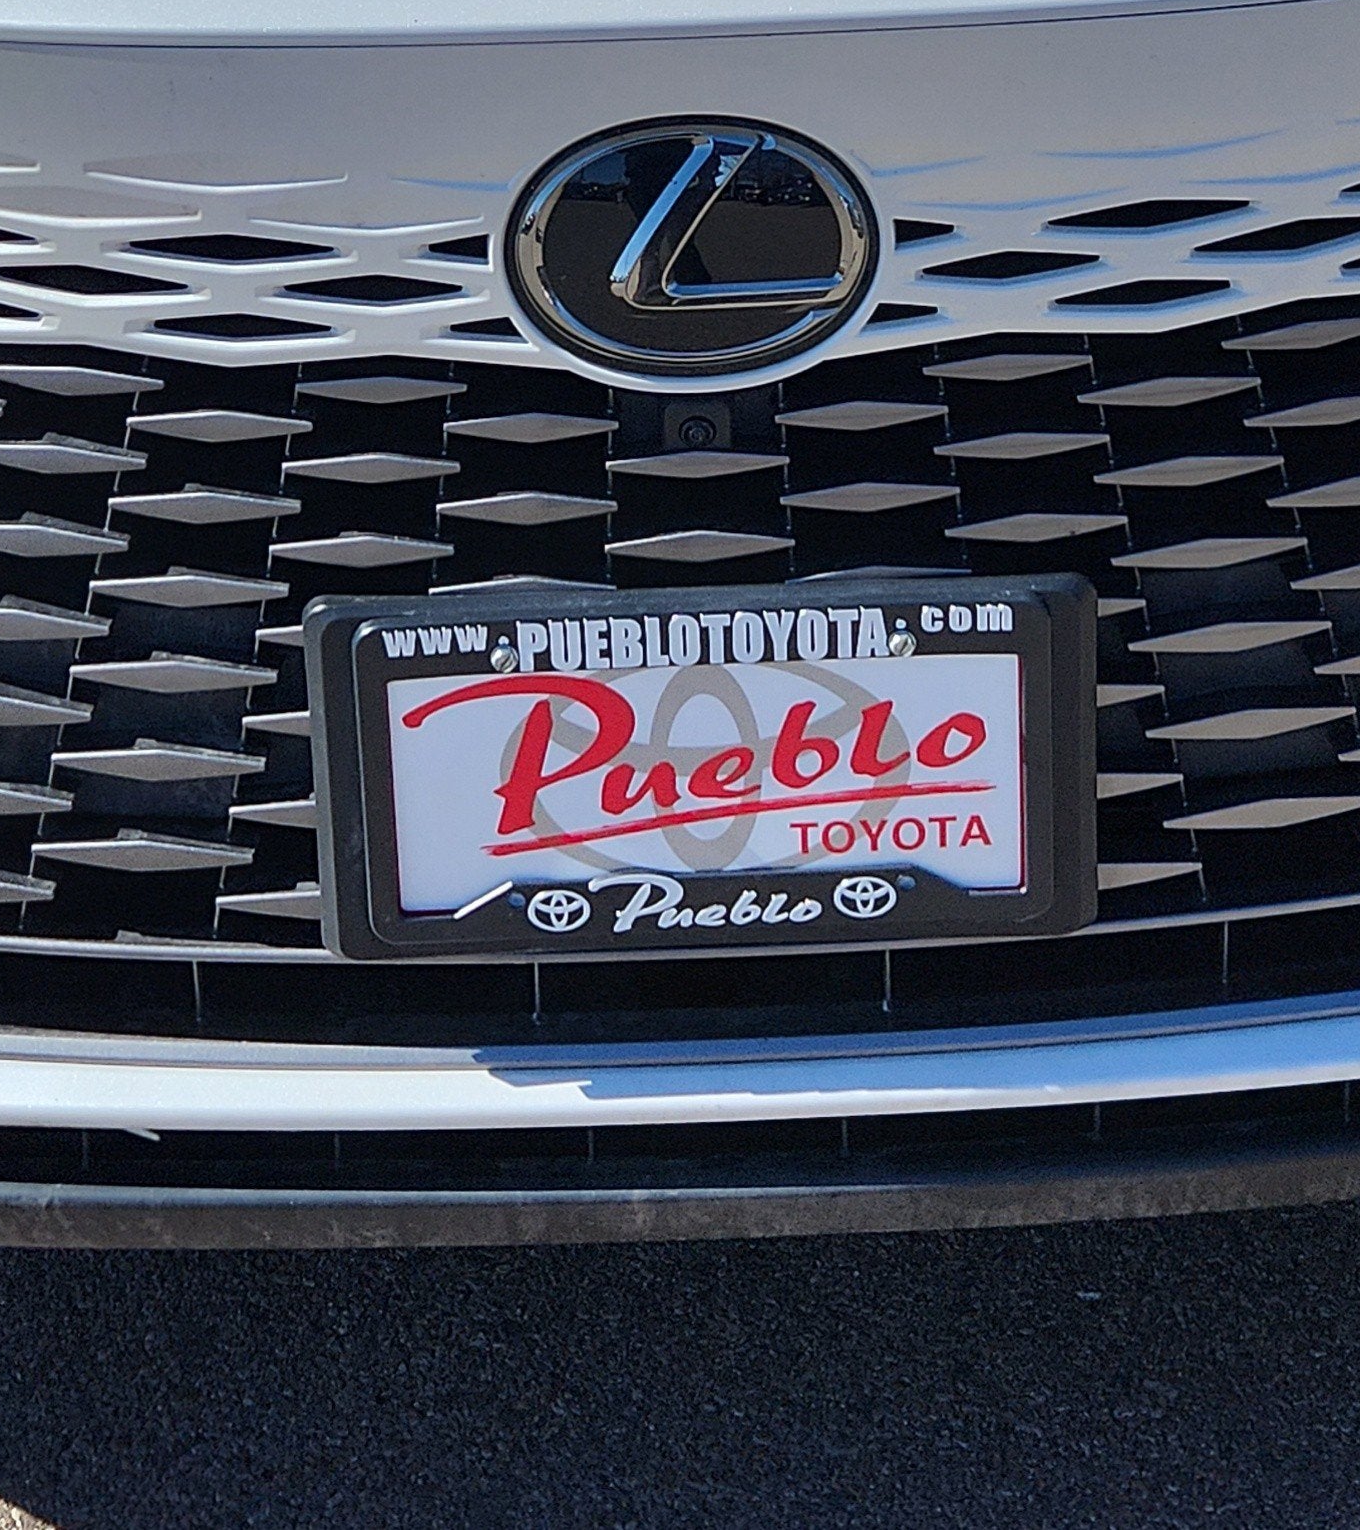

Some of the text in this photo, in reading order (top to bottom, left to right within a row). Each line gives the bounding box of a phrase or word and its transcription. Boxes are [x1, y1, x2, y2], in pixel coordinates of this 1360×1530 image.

[402, 674, 987, 834] Pueblo
[789, 815, 992, 854] TOYOTA
[589, 873, 823, 933] Pueblo
